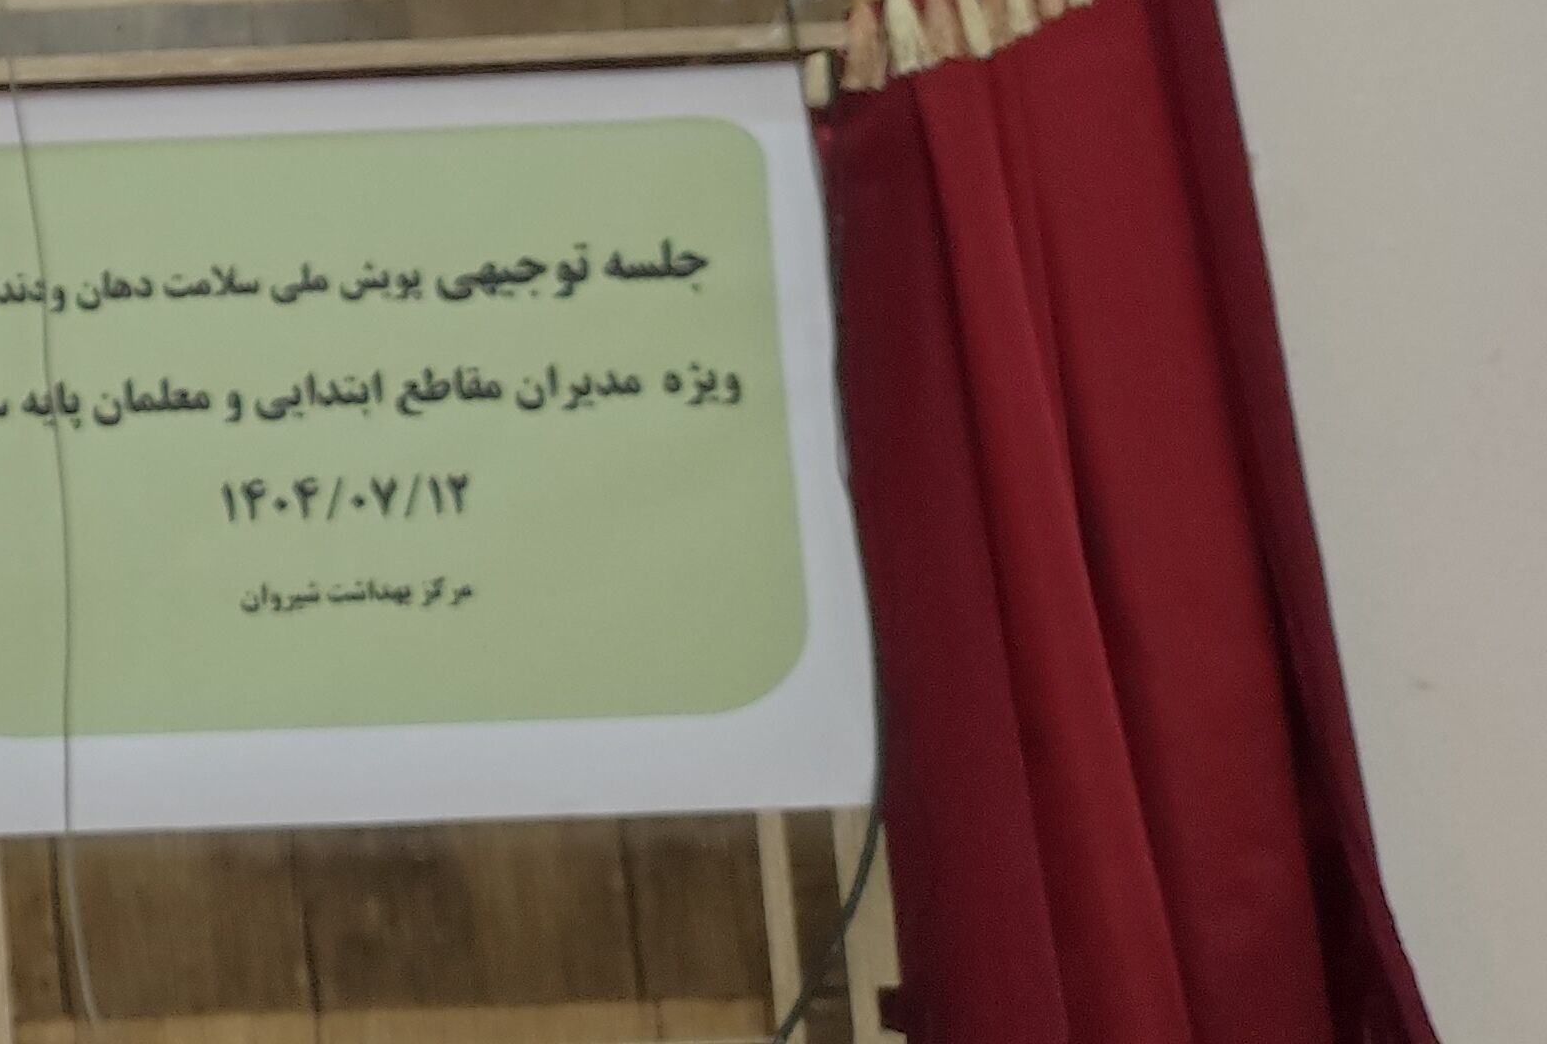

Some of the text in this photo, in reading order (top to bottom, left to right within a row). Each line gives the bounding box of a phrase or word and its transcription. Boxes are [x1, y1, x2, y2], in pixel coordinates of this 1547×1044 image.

[162, 265, 262, 300] سلامت
[270, 262, 331, 306] ملی
[339, 262, 423, 303] پویش
[434, 242, 592, 303] توجیهی
[603, 238, 710, 293] جلسه
[75, 270, 155, 312] دهان
[21, 380, 82, 430] پایه
[92, 377, 213, 428] معلمان
[224, 389, 245, 424] و
[253, 369, 385, 423] ابتدایی
[395, 366, 504, 418] مقاطع
[515, 364, 643, 413] مدیران
[662, 362, 743, 408] ویژه
[240, 575, 474, 613] مرکز بهداشت شیروان
